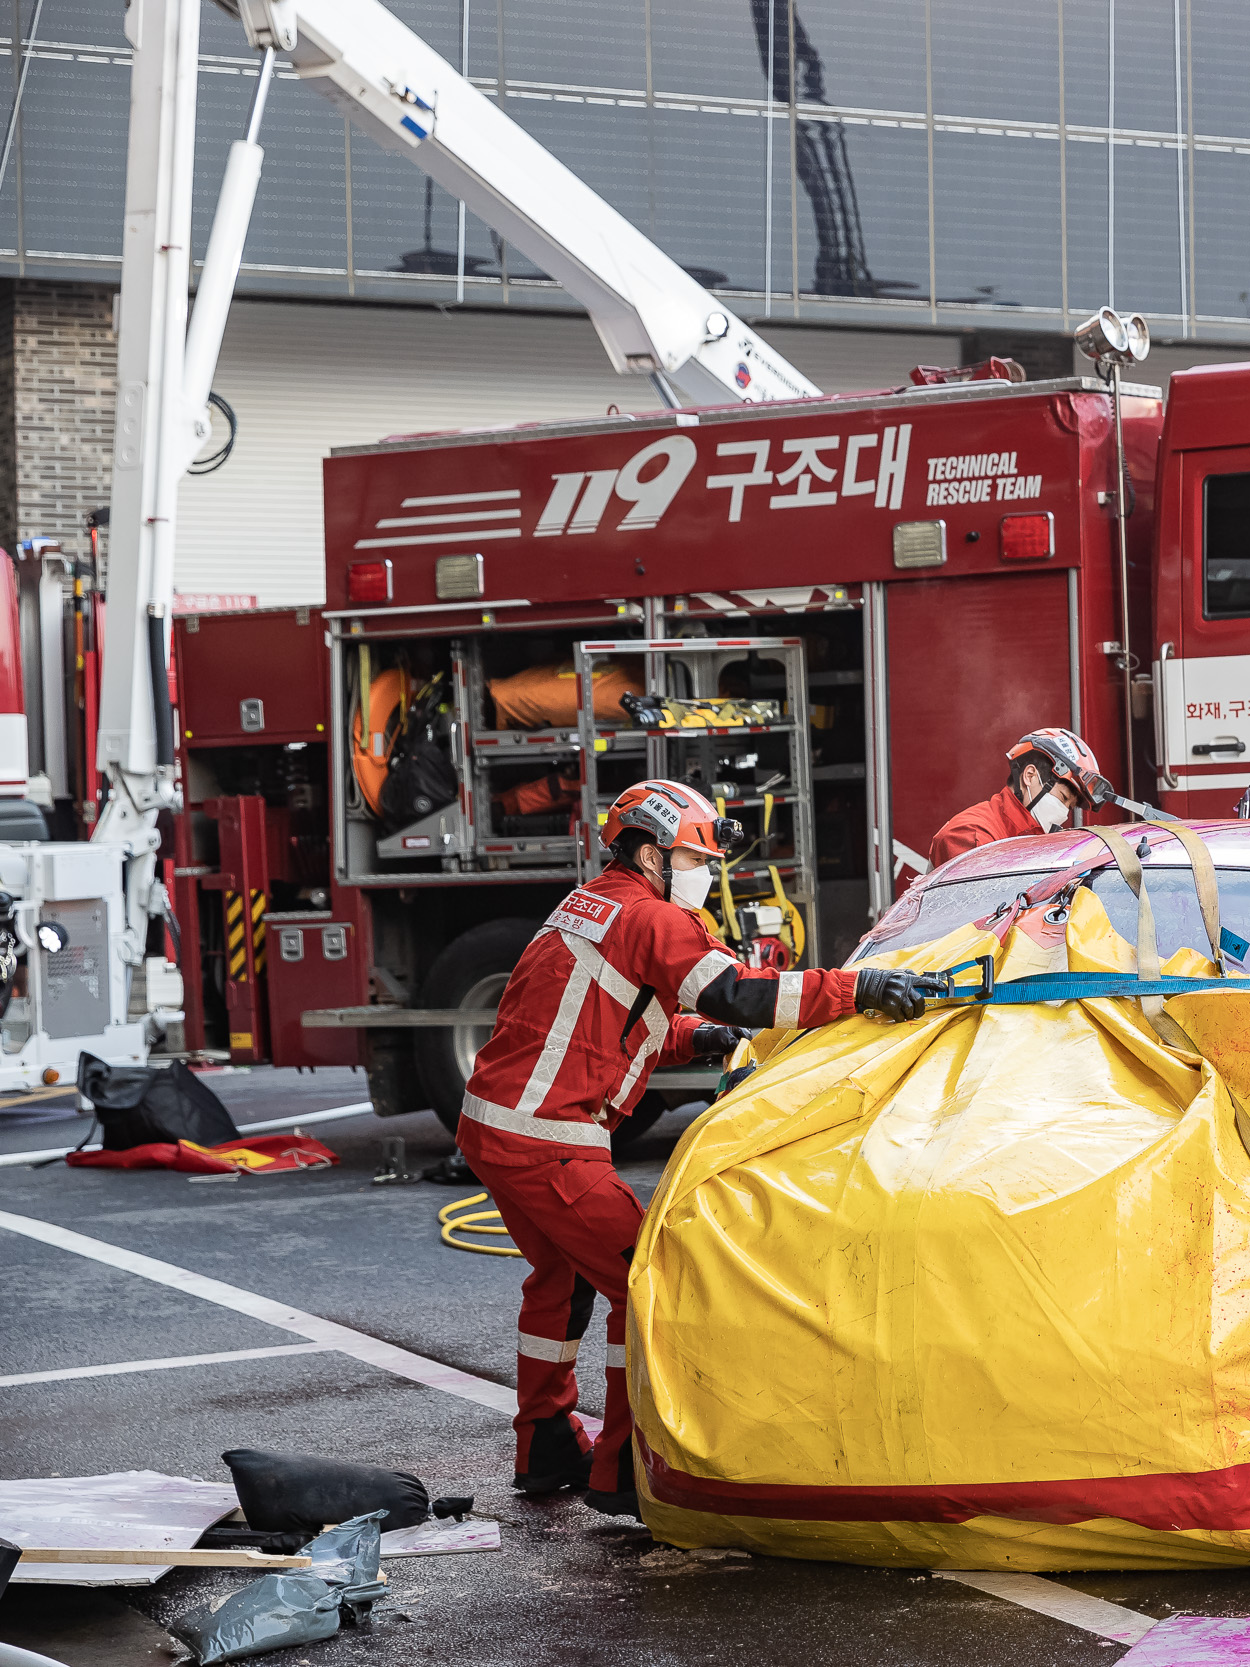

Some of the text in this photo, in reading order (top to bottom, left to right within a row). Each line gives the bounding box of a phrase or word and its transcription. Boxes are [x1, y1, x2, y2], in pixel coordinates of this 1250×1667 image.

[533, 423, 912, 537] 119 구조대
[927, 451, 1018, 481] TECHNICAL
[925, 474, 1043, 506] RESCUE TEAM
[646, 797, 678, 825] 서울광진
